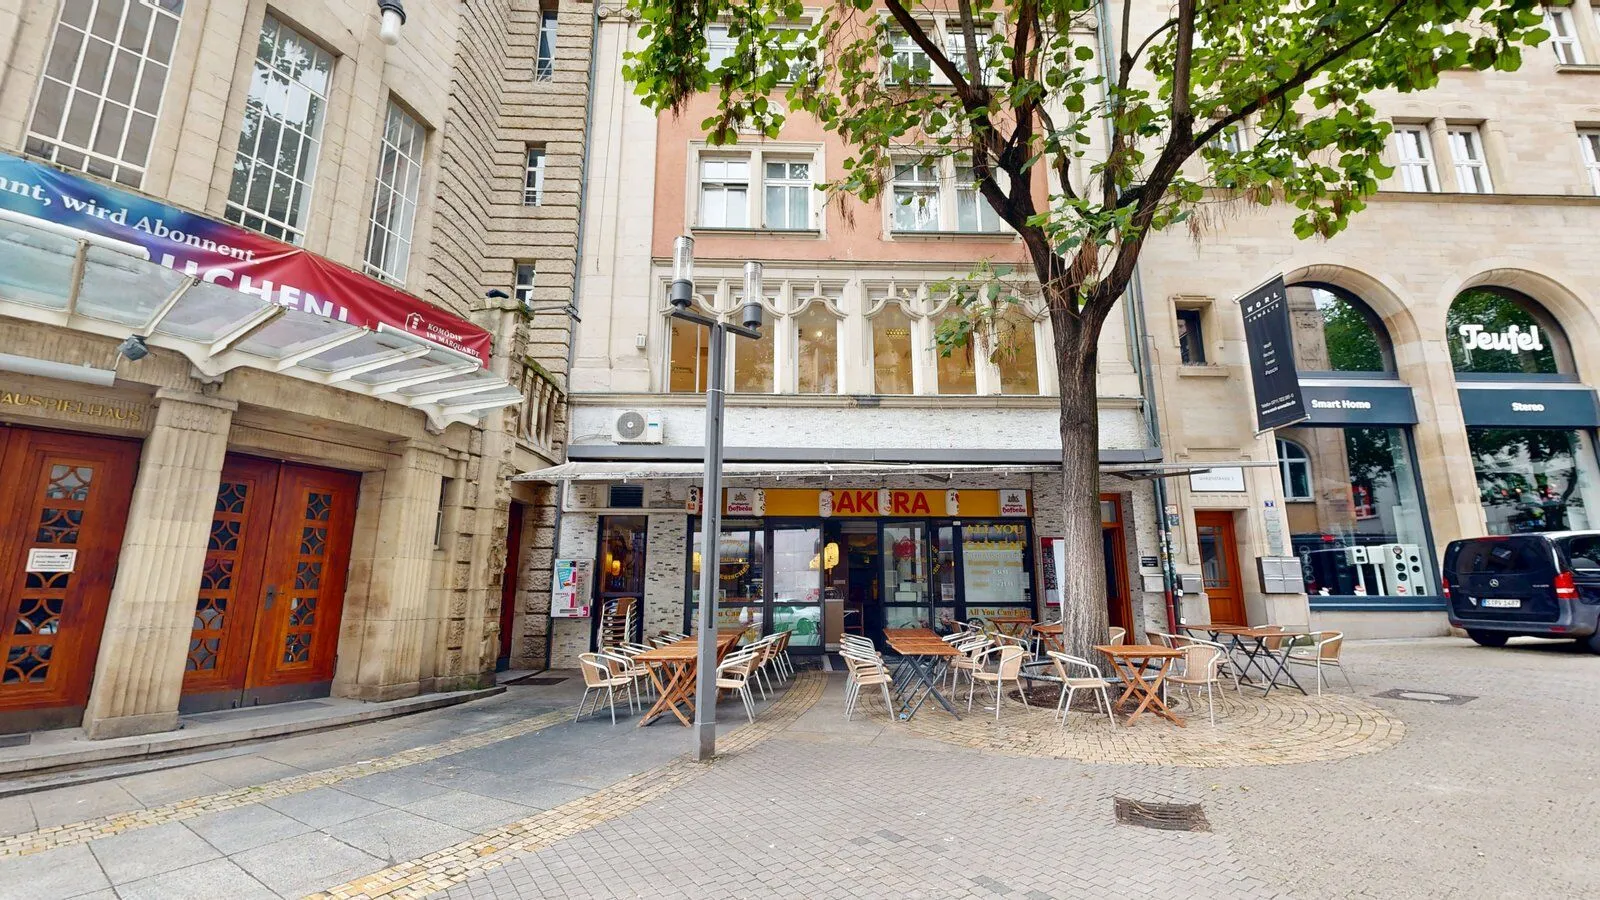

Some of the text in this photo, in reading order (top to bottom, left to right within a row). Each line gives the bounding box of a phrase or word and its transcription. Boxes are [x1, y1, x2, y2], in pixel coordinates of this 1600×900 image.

[61, 194, 128, 226] wird
[1246, 292, 1279, 313] WORL
[426, 323, 464, 343] KOMÖDIE
[1458, 324, 1543, 354] Teufel
[438, 336, 480, 357] MARQUARDT
[0, 391, 141, 421] AUSPIELHAUS
[1311, 400, 1371, 409] Smart Home
[1511, 402, 1545, 412] Stereo
[967, 524, 1024, 534] ALL YOU
[968, 608, 979, 616] All
[981, 608, 995, 616] You
